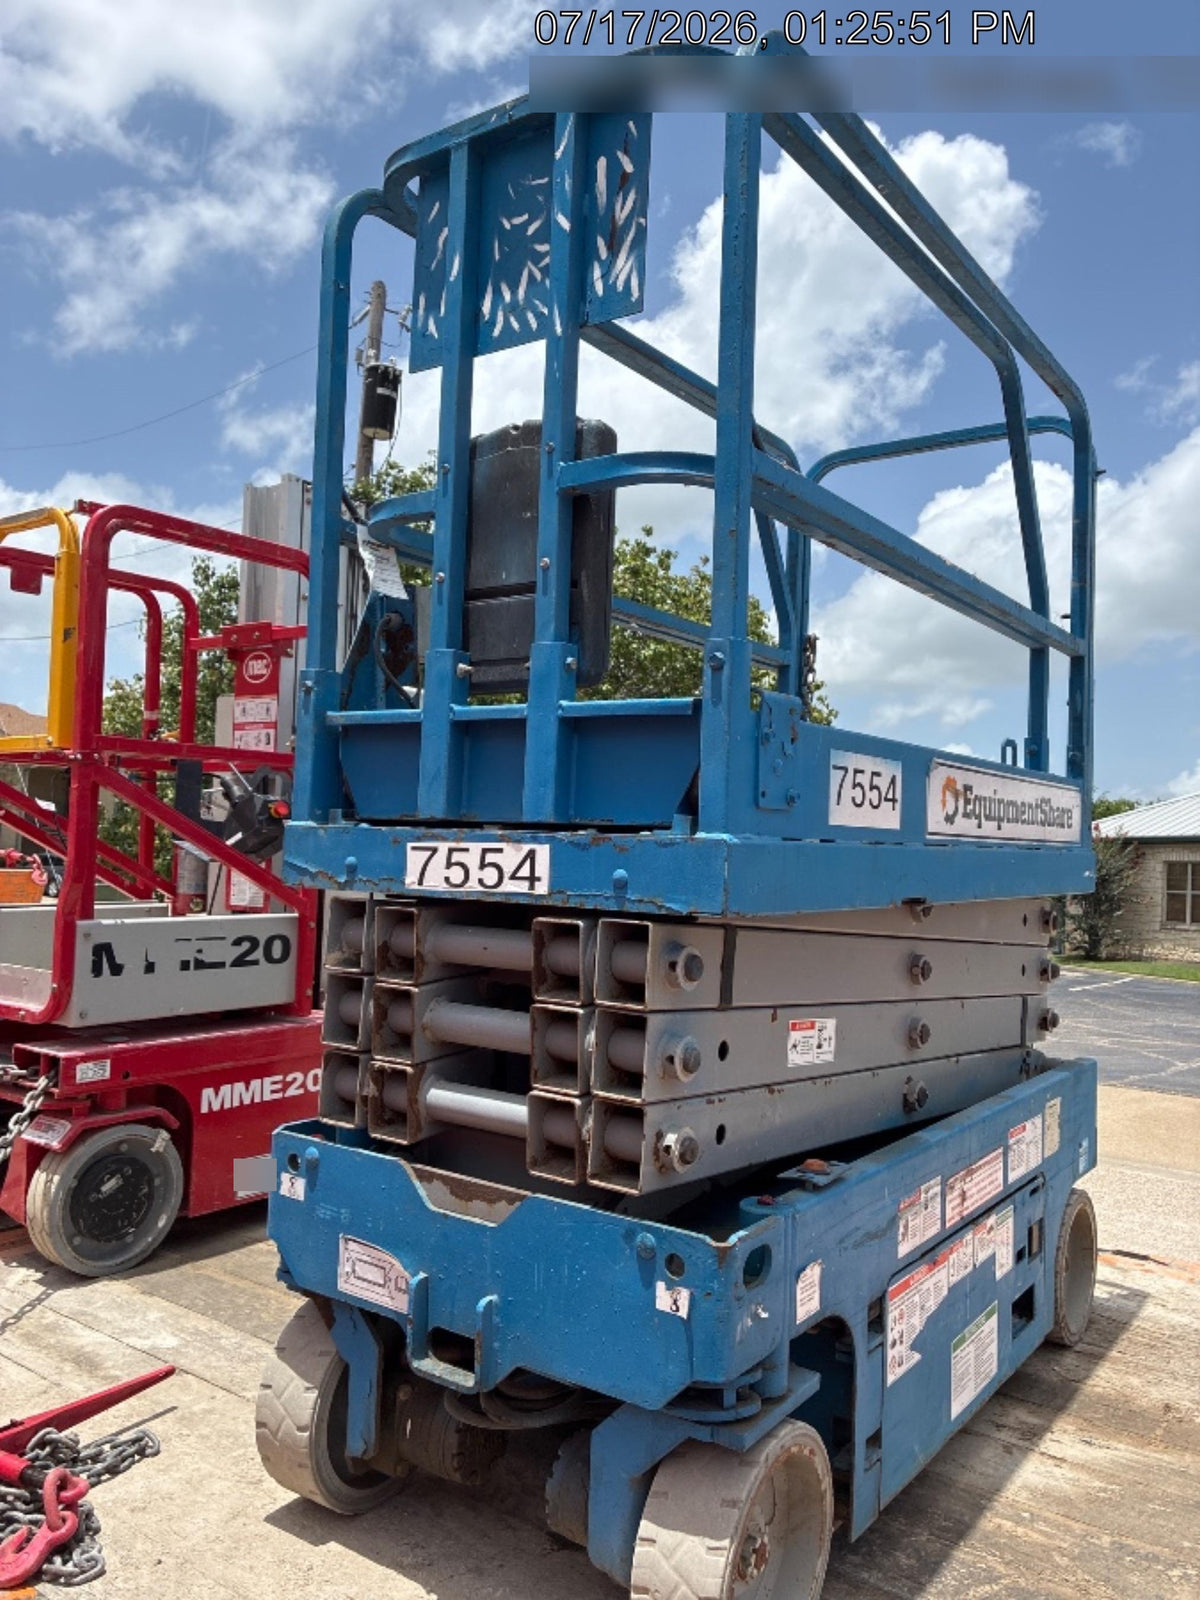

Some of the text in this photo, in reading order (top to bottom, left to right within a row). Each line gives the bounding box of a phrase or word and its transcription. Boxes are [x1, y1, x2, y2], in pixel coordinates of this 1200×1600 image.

[831, 764, 899, 811] 7554
[961, 784, 1073, 830] EquipmentShare
[410, 846, 542, 891] 7554
[200, 1067, 322, 1114] MME20
